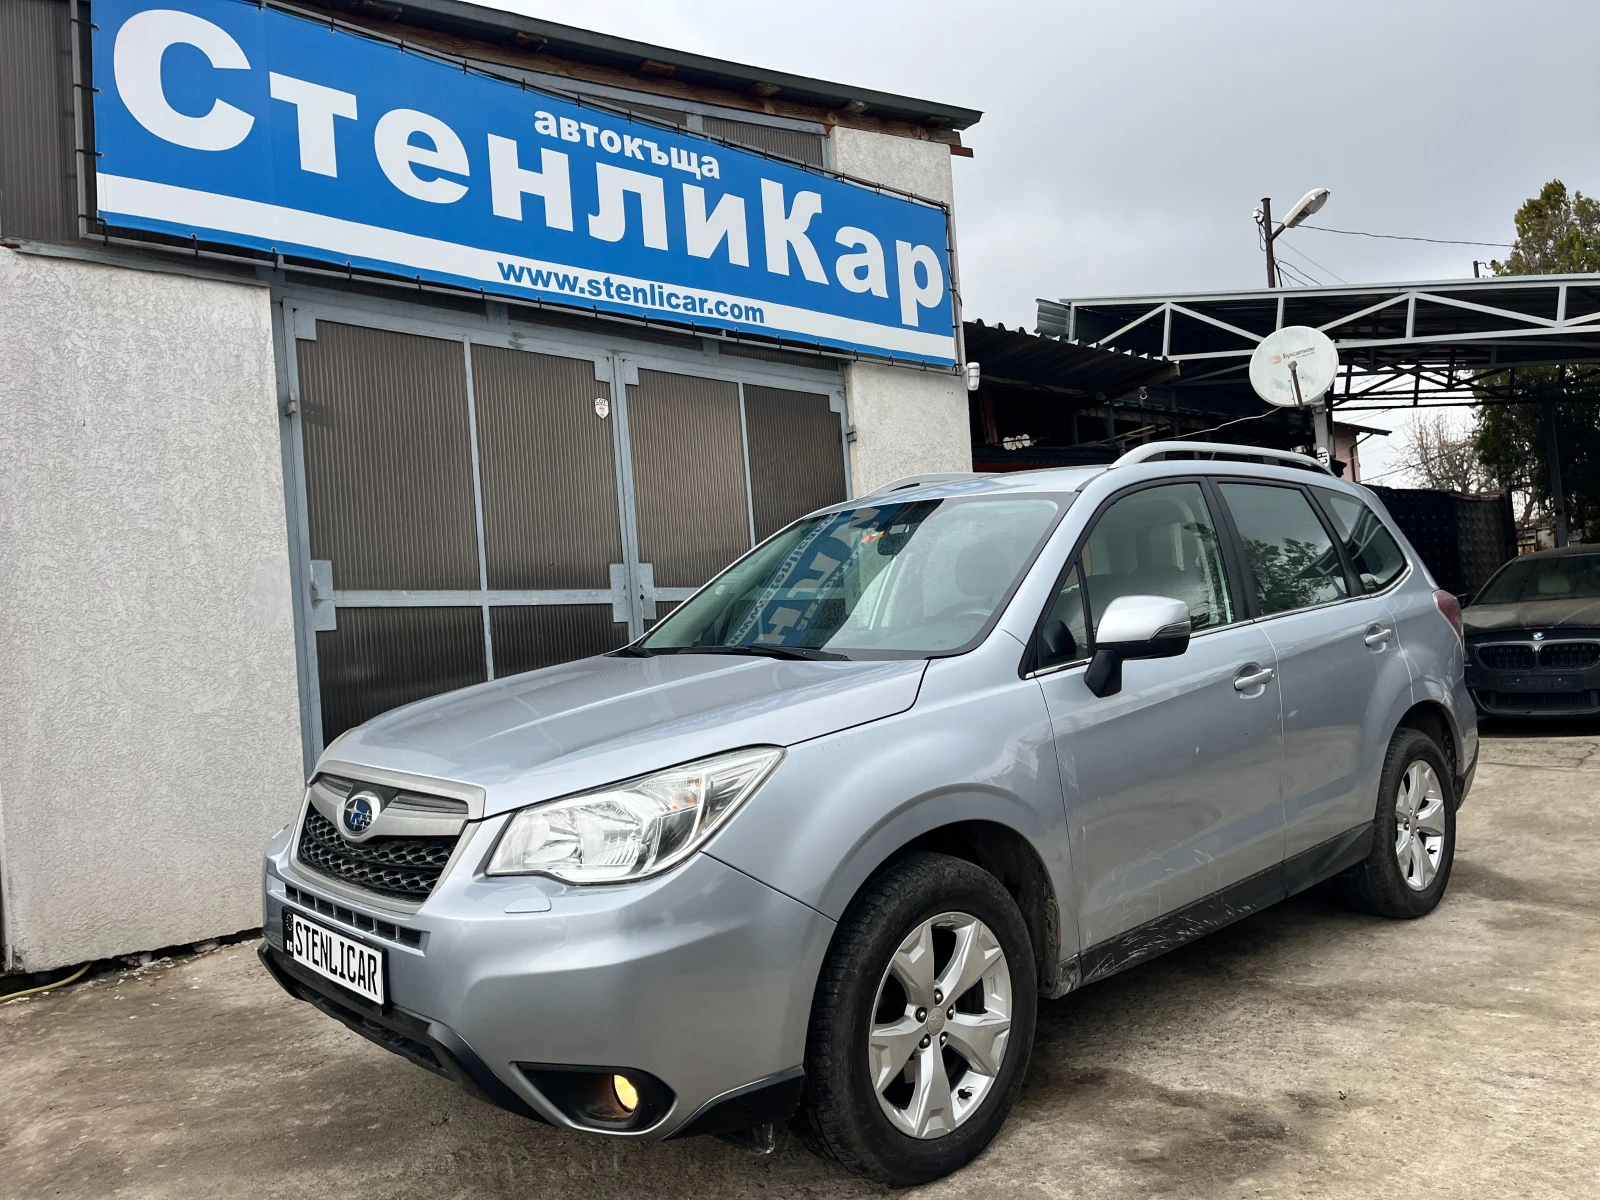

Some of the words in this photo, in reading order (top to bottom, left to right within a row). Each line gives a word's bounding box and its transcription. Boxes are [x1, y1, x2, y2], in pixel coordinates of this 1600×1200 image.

[114, 10, 943, 326] СтенлиКар
[534, 110, 720, 180] автокъща
[497, 261, 765, 323] www.stenlicar.com
[295, 920, 378, 996] STENLICAR
